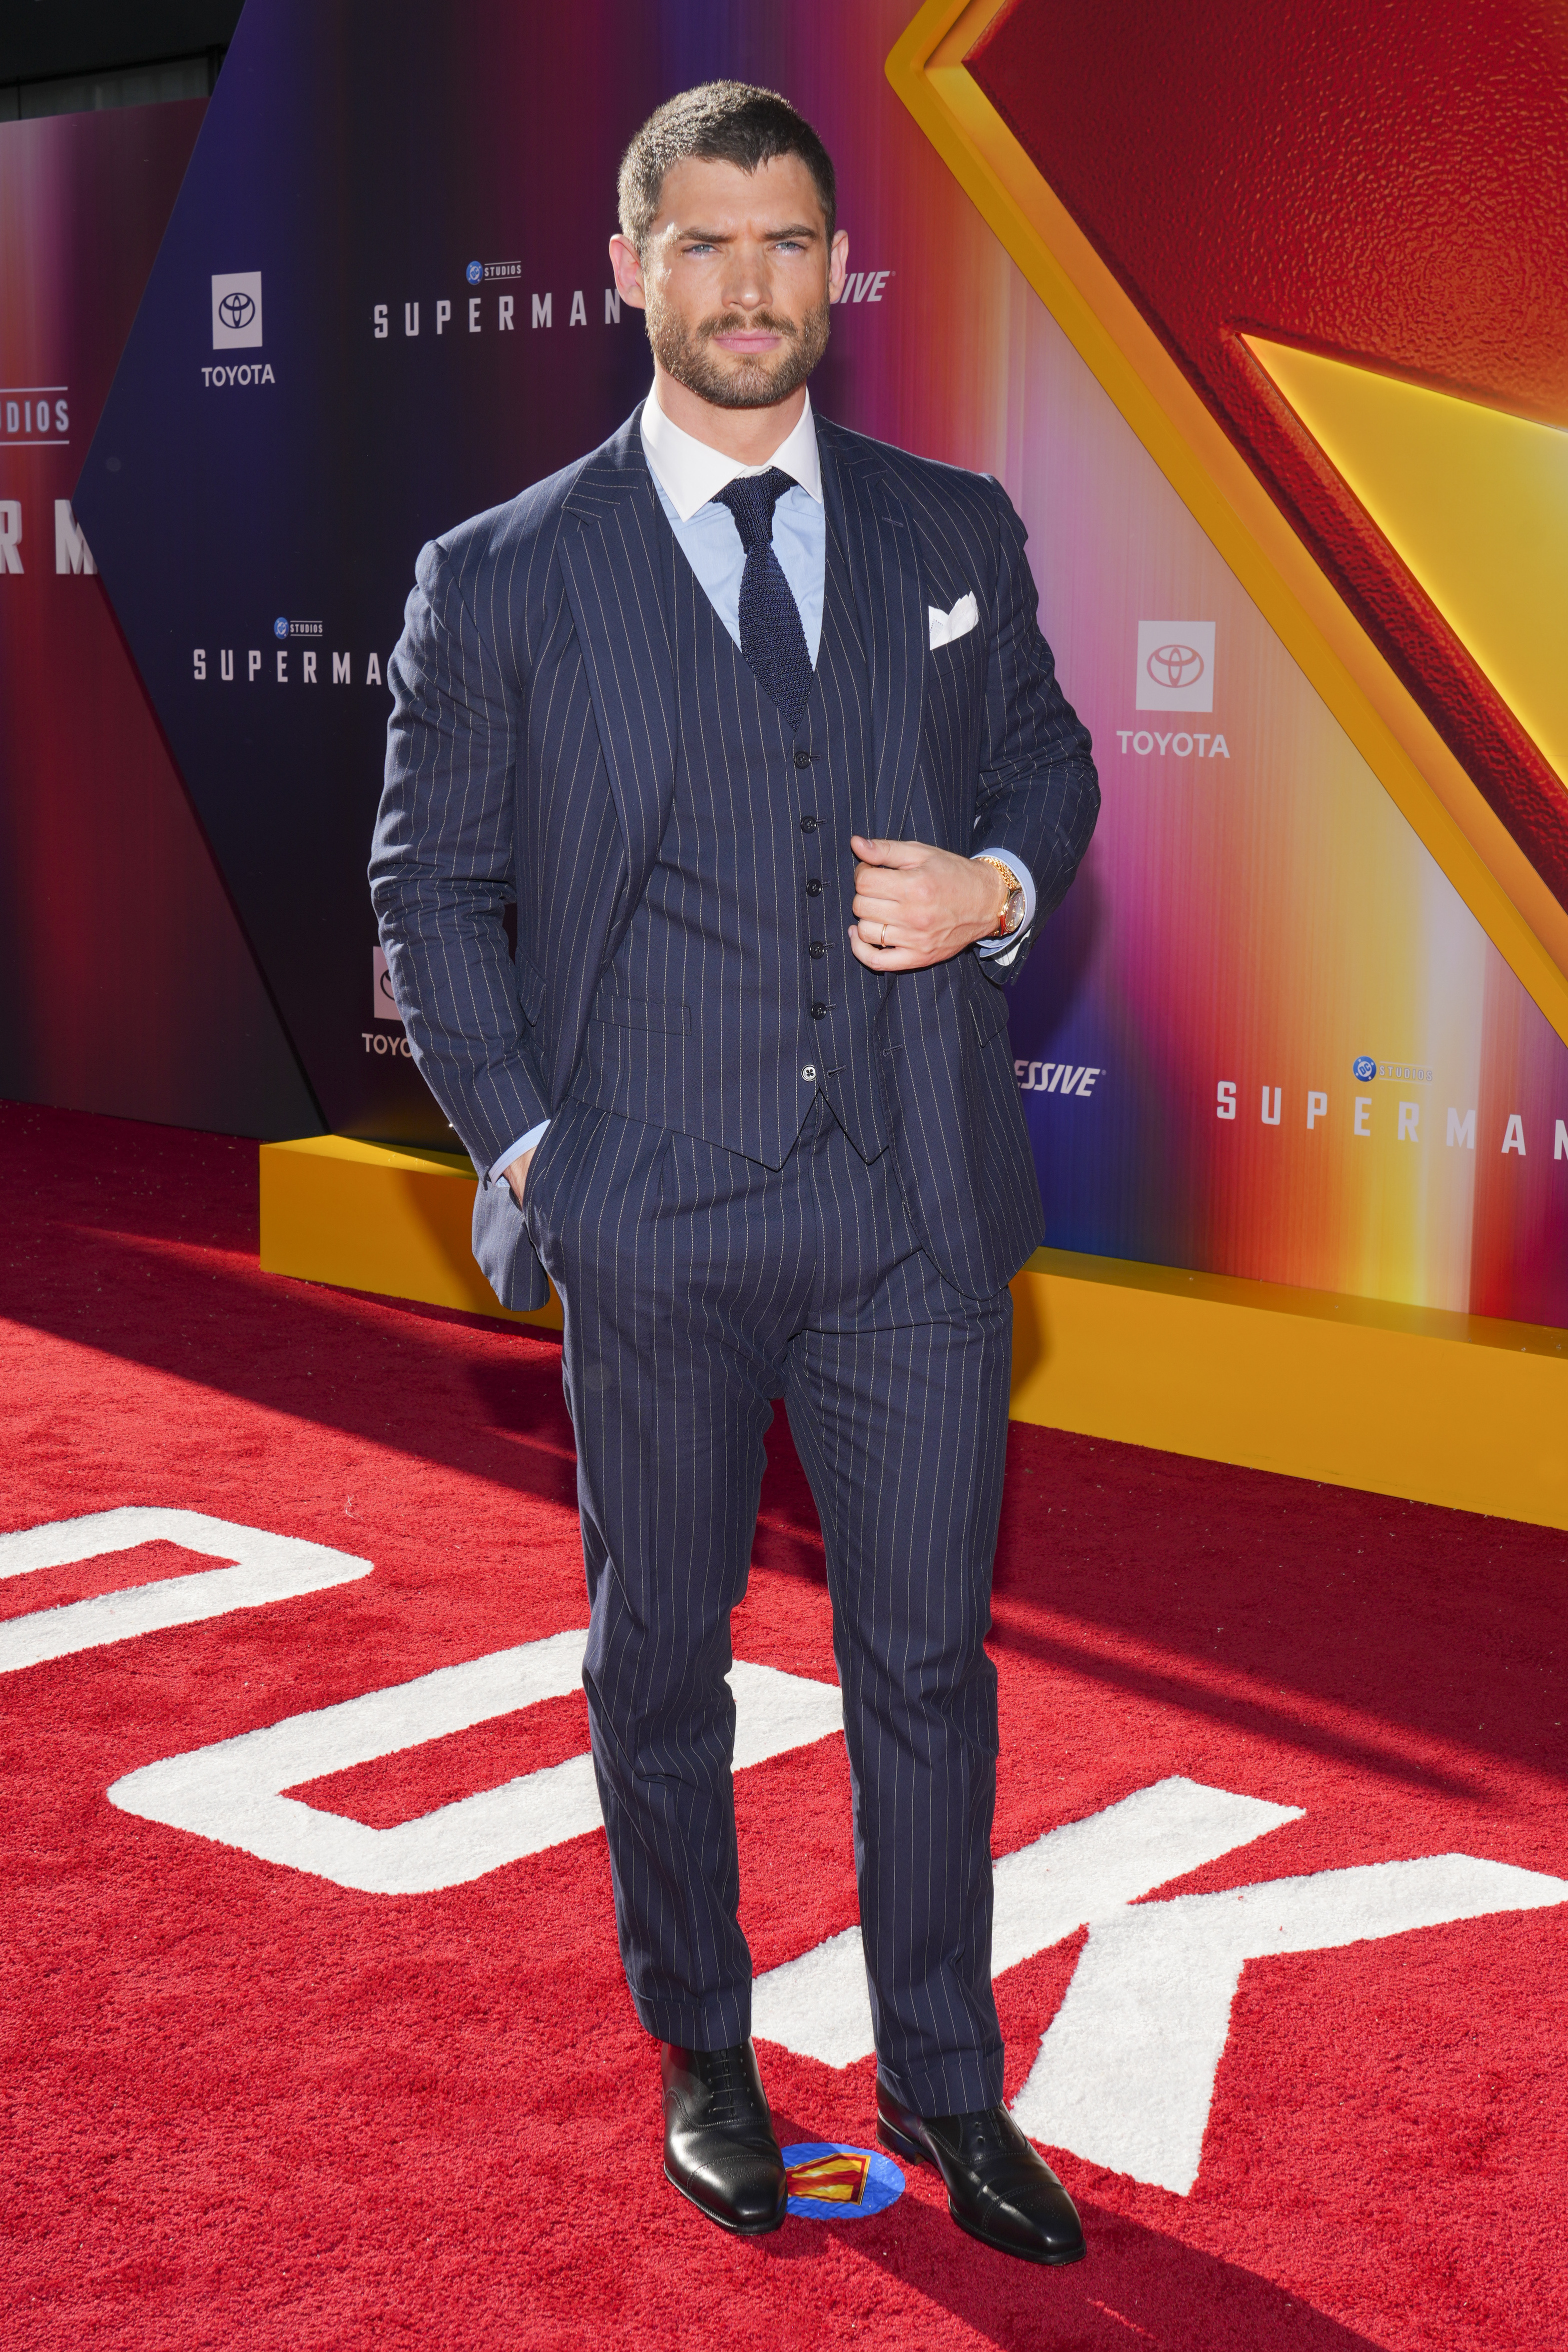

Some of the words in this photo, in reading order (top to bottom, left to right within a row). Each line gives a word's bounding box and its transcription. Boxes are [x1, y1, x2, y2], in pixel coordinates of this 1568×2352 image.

[484, 265, 521, 276] STUDIOS
[374, 288, 620, 338] SUPERMAN
[201, 363, 275, 387] TOYOTA
[0, 399, 69, 433] DIOS
[290, 624, 323, 633] STUDIOS
[193, 649, 381, 685] SUPERMA
[1116, 730, 1230, 758] TOYOTA
[361, 1033, 412, 1058] TOYO
[1014, 1060, 1101, 1097] ESSIVE
[1379, 1065, 1433, 1081] STUDIOS
